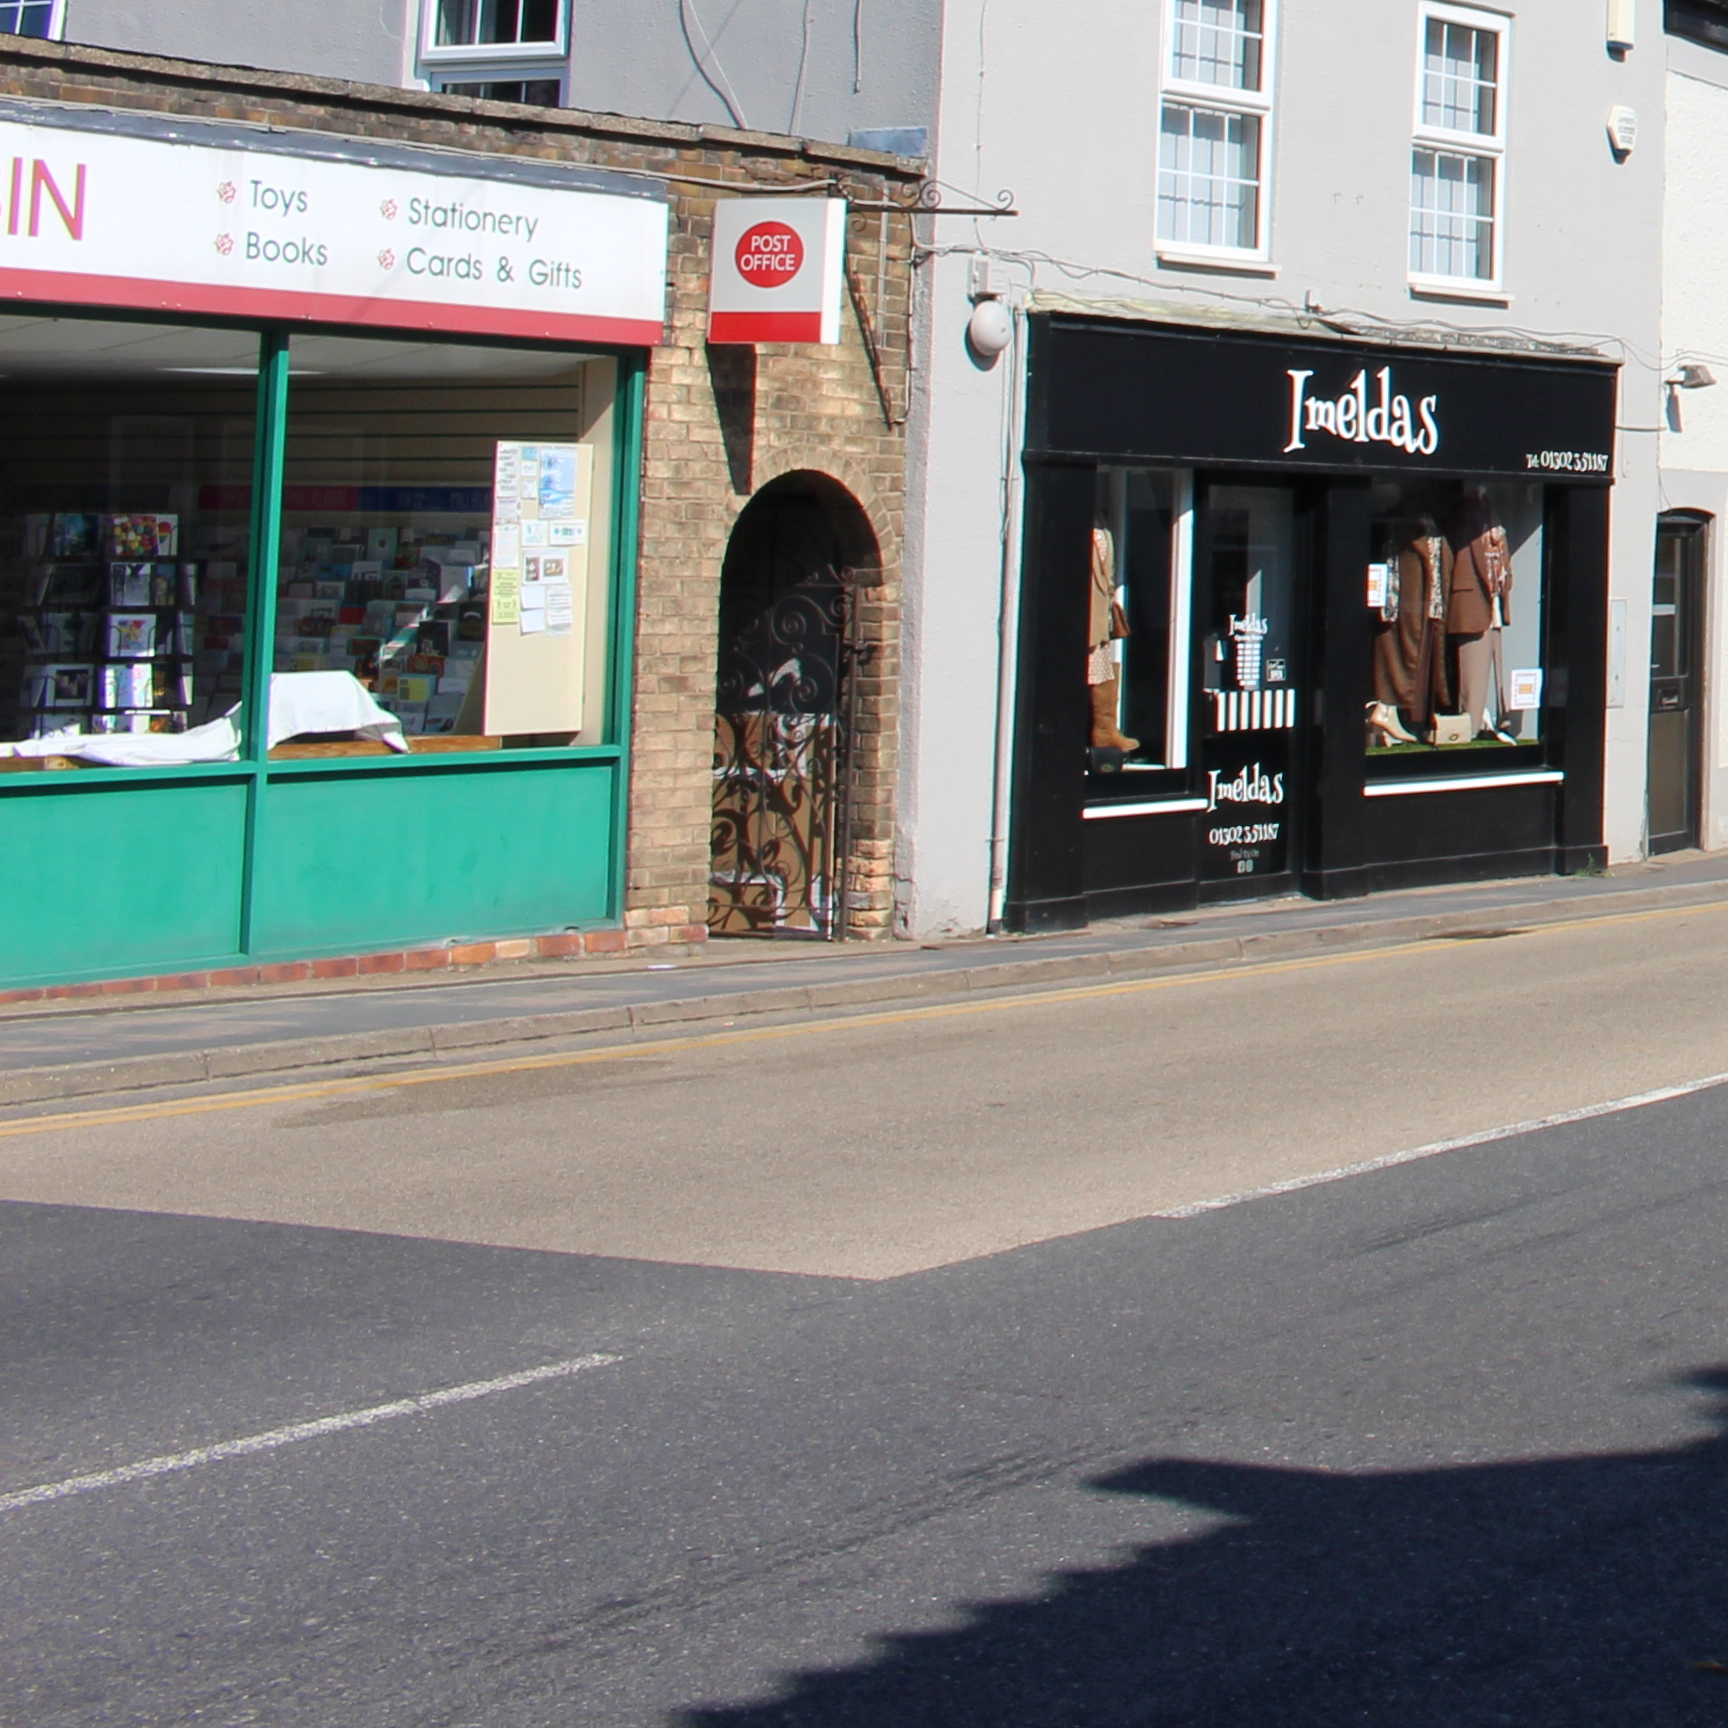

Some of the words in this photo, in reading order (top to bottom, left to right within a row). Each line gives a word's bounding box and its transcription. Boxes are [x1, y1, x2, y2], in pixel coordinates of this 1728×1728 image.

[0, 157, 87, 241] IN
[251, 180, 308, 217] Toys
[409, 198, 539, 243] Stationery
[246, 232, 328, 266] Books
[741, 254, 795, 271] OFFICE
[751, 235, 791, 252] POST
[407, 247, 483, 281] Cards
[497, 256, 515, 282] &
[529, 260, 583, 289] Gifts
[1283, 365, 1440, 455] Imeldas
[1207, 762, 1284, 813] Imeldas
